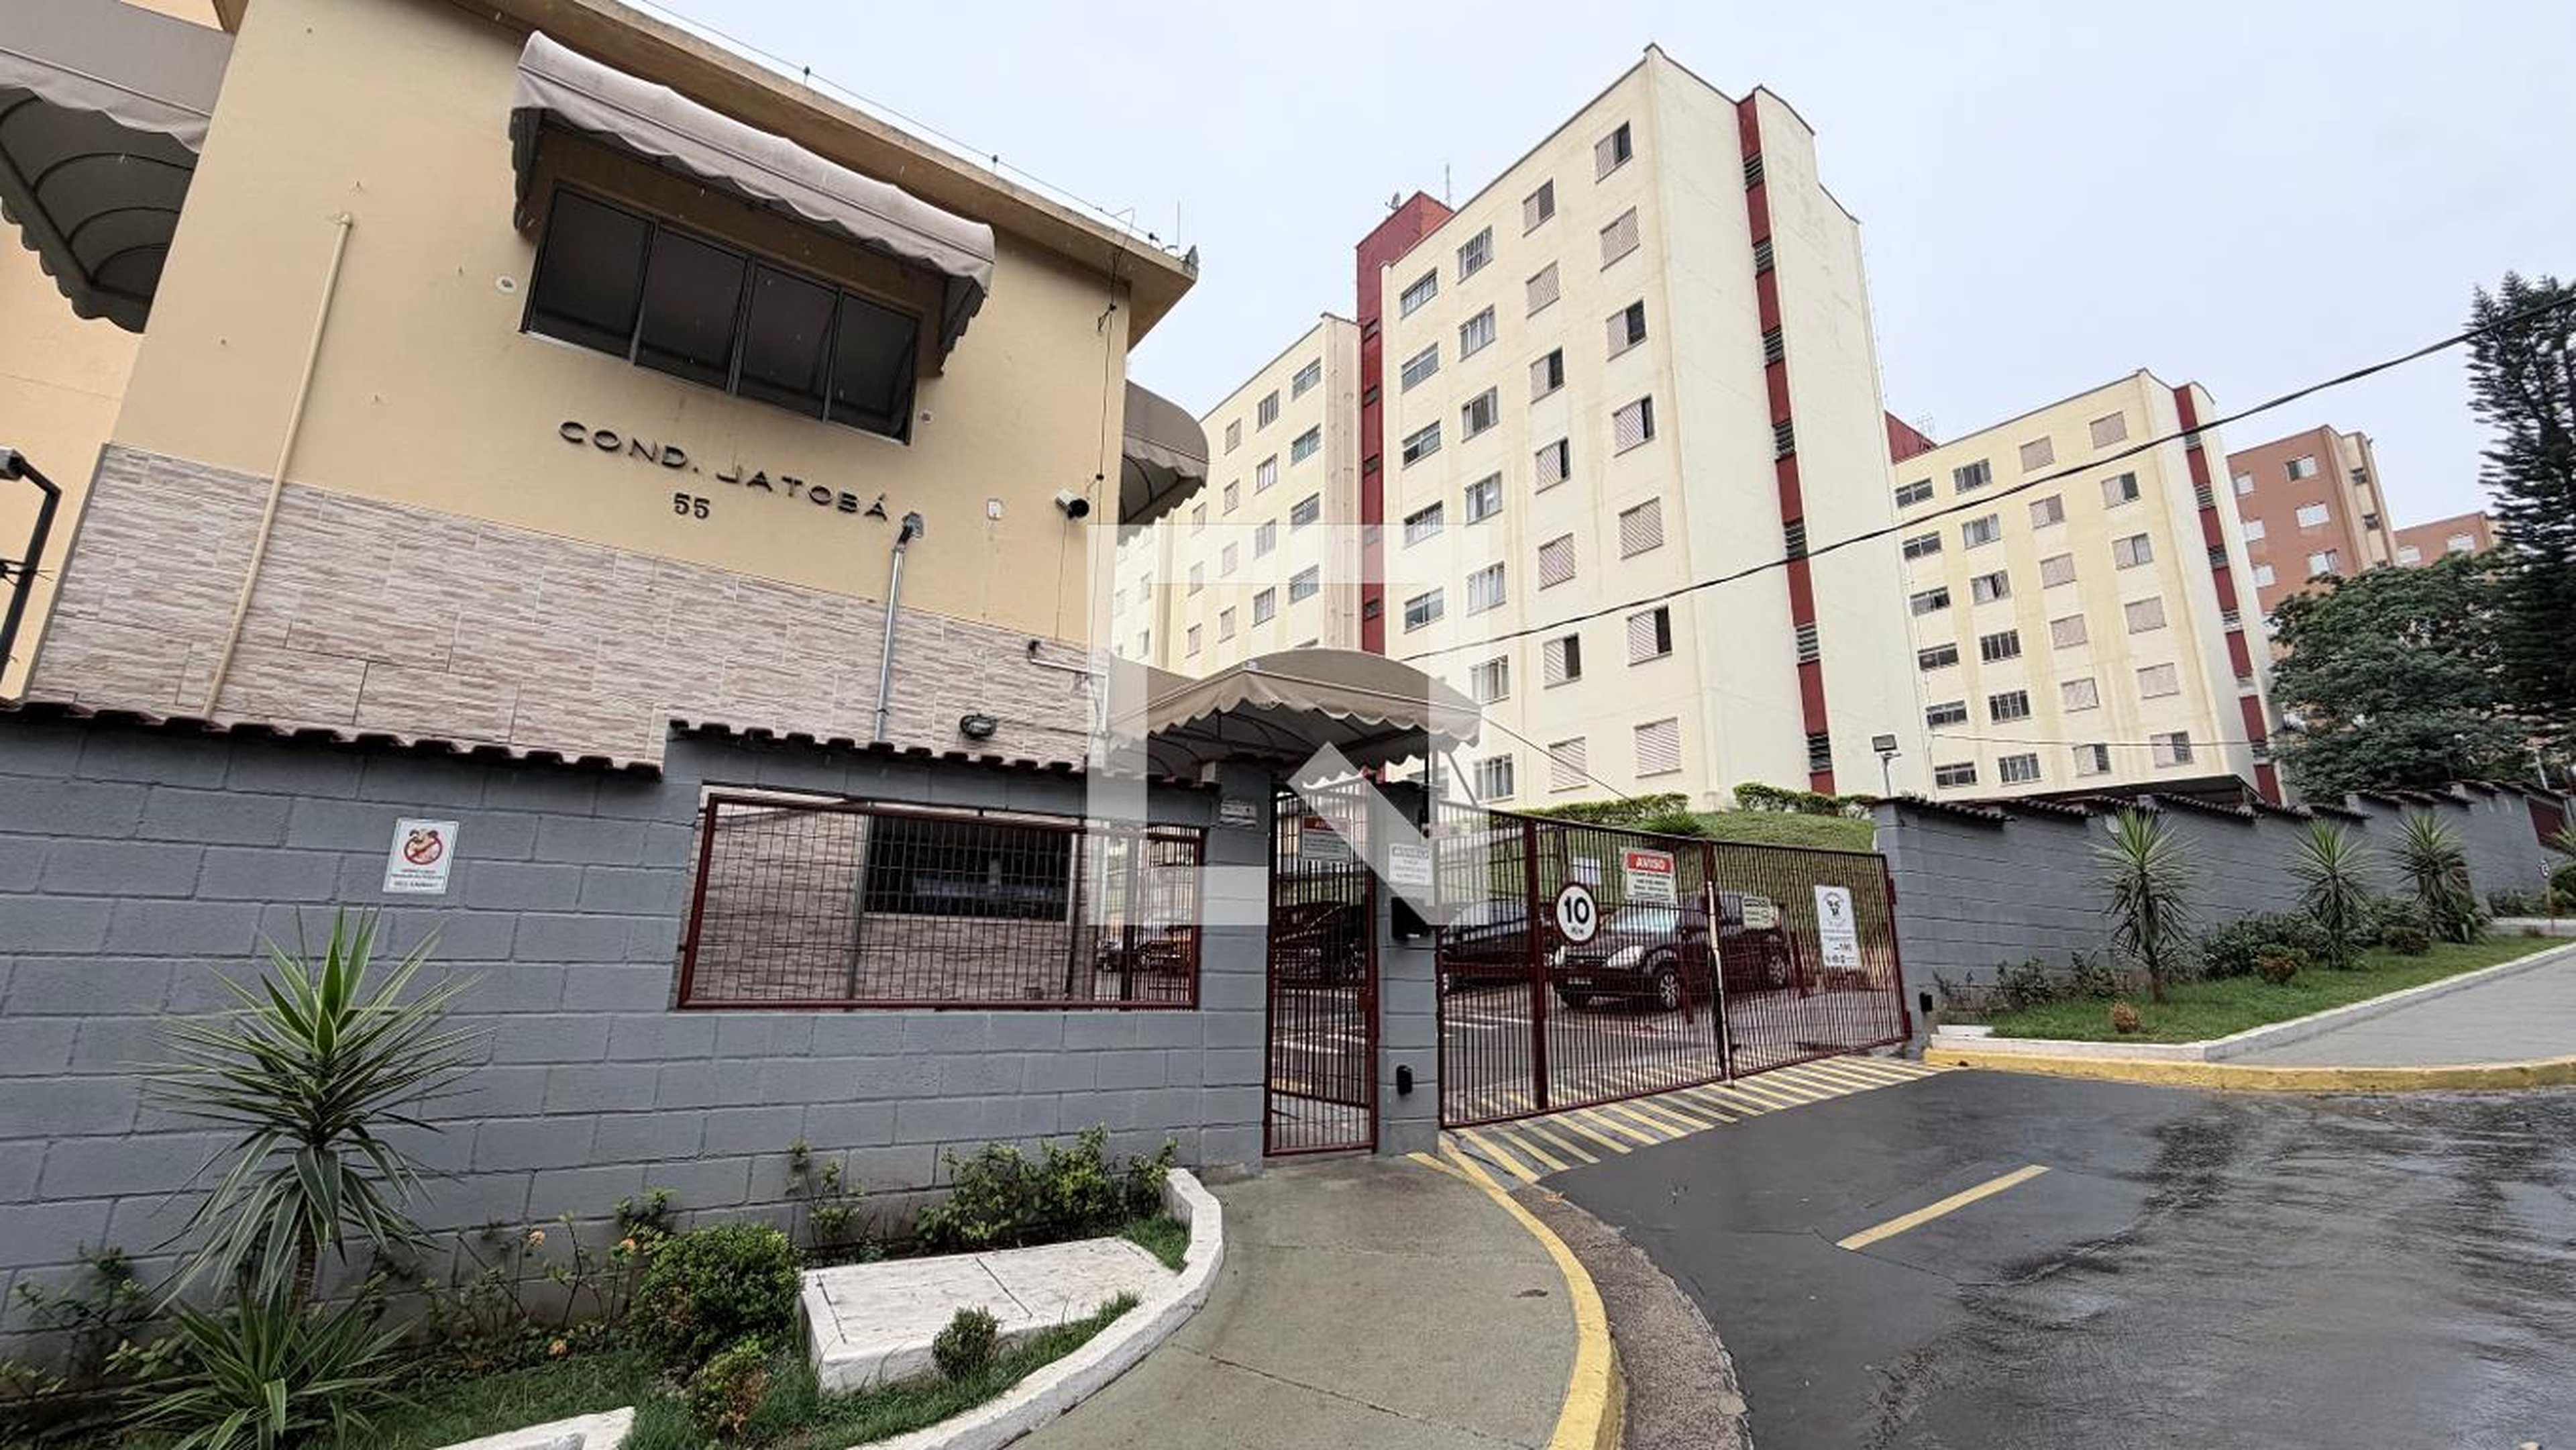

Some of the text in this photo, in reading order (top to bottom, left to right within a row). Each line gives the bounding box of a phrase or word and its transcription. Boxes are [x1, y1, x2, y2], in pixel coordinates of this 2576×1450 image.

[558, 420, 889, 523] COND. JATOBÁ
[674, 492, 712, 521] 55
[1635, 856, 1666, 871] AVISO
[1564, 895, 1590, 925] 10
